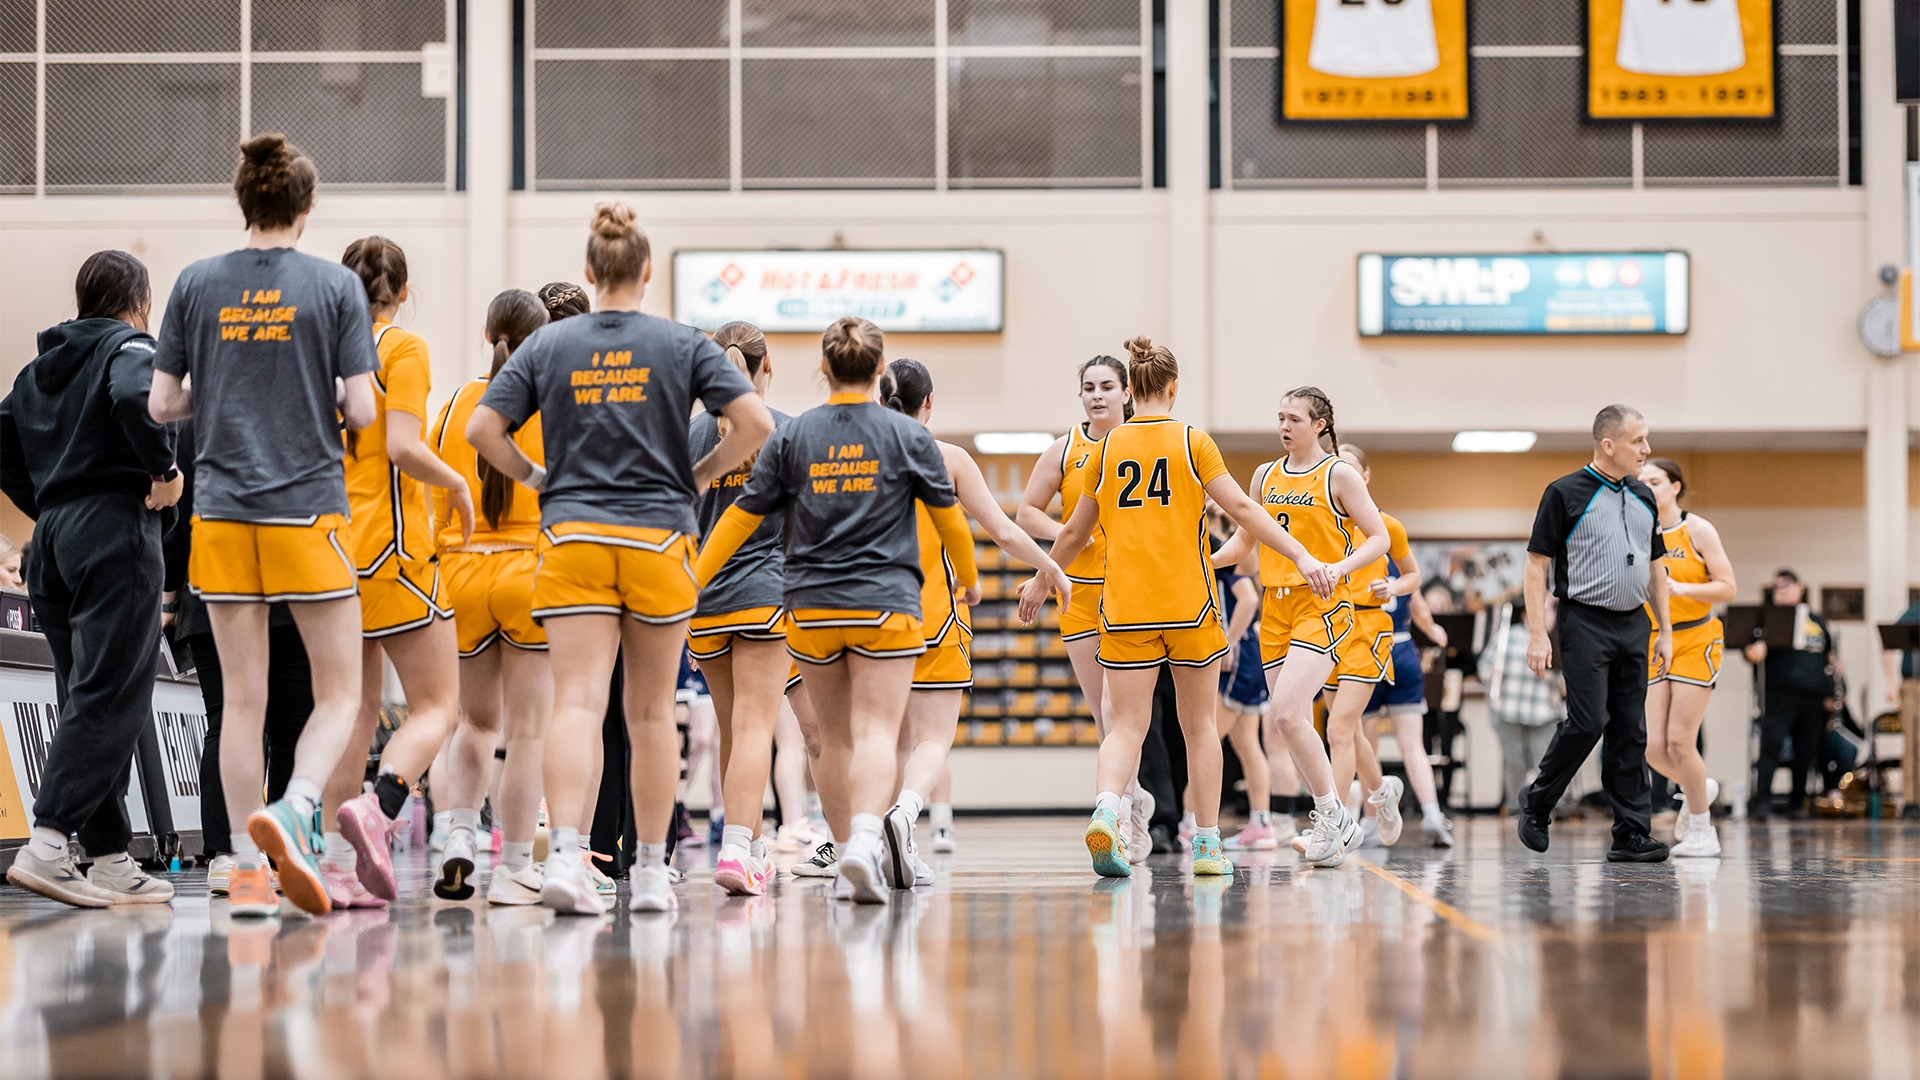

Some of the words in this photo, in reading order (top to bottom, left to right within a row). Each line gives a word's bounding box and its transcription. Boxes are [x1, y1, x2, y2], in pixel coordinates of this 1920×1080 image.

[241, 290, 250, 304] I
[252, 289, 282, 304] AM
[219, 306, 297, 323] BECAUSE
[221, 325, 250, 341] WE
[253, 325, 292, 341] ARE.
[592, 352, 600, 368] I
[602, 350, 632, 367] AM
[570, 367, 651, 387] BECAUSE
[574, 388, 603, 405] WE
[606, 385, 648, 403] ARE.
[828, 445, 835, 460] I
[837, 444, 864, 459] AM
[809, 460, 880, 478] BECAUSE
[812, 479, 838, 494] WE
[841, 477, 878, 493] ARE.
[1117, 457, 1172, 508] 24
[1263, 486, 1316, 507] Jackets
